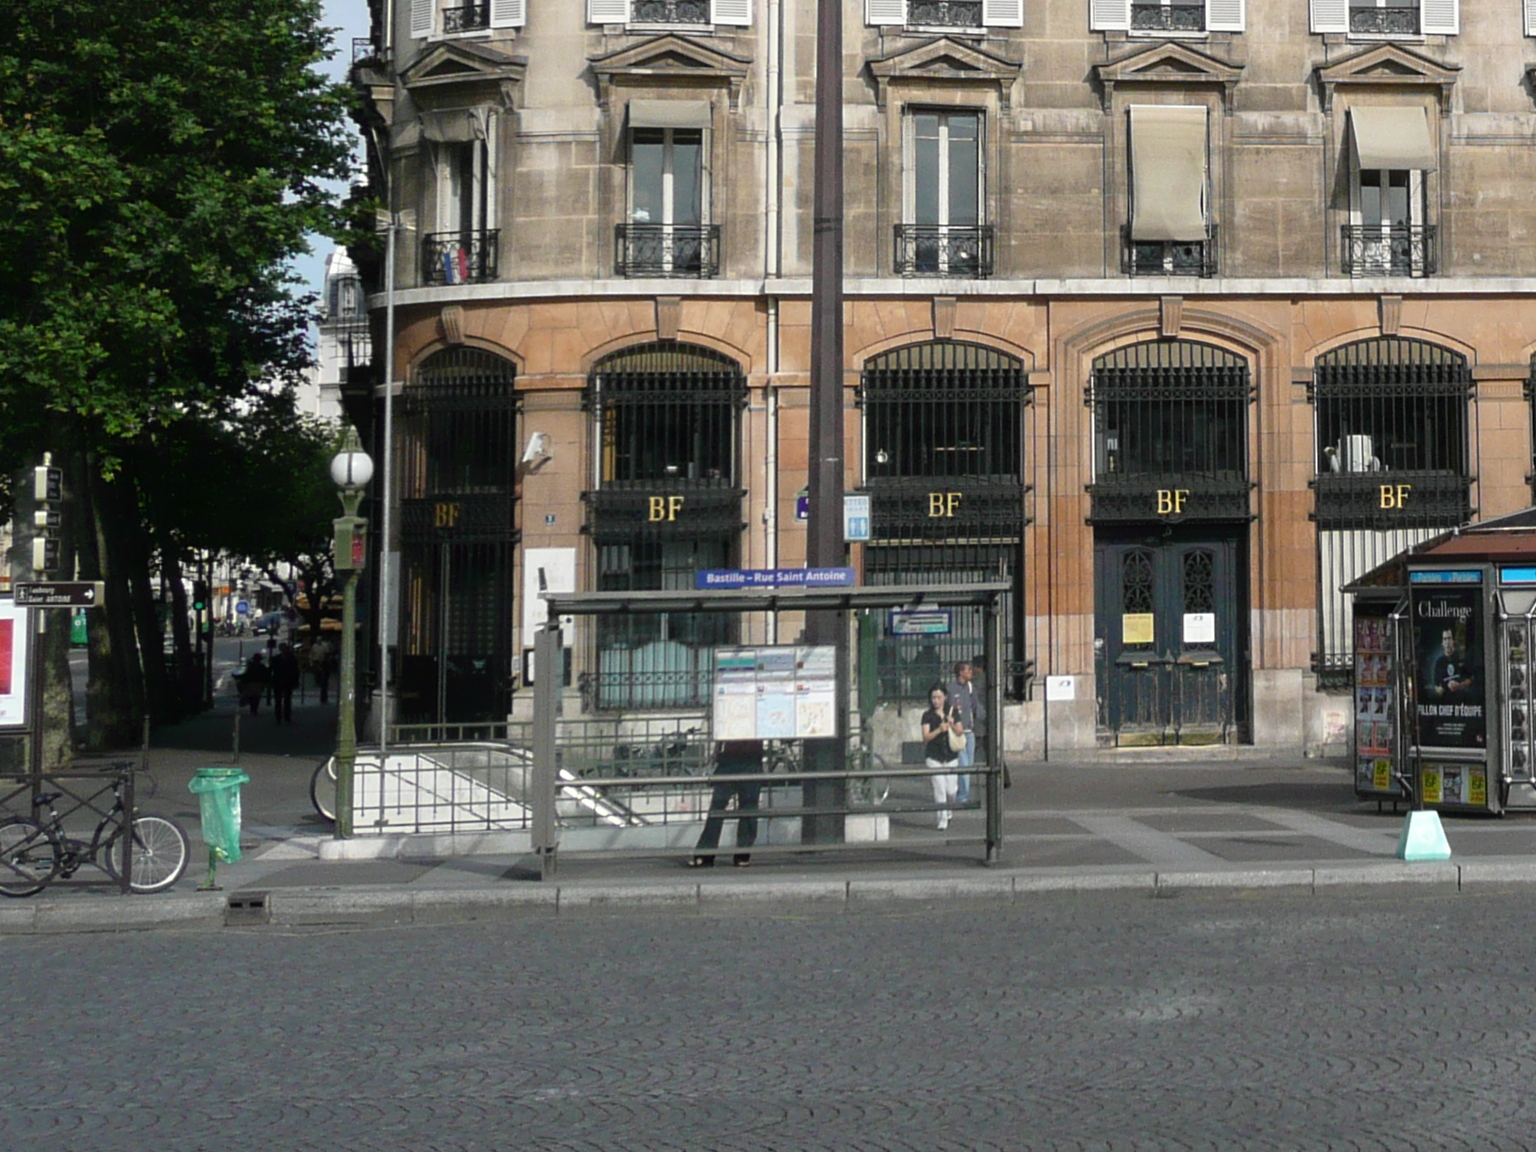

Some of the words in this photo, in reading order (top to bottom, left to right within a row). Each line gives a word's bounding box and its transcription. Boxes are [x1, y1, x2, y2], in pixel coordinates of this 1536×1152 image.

[648, 496, 684, 522] BF
[928, 492, 962, 517] BF
[1156, 489, 1190, 514] BF
[1379, 484, 1412, 509] BF
[434, 502, 460, 528] BF
[706, 573, 745, 583] Bastille
[754, 572, 774, 582] Rue
[776, 572, 803, 582] Saint
[806, 571, 846, 581] Antoine
[1418, 600, 1472, 623] Challenge
